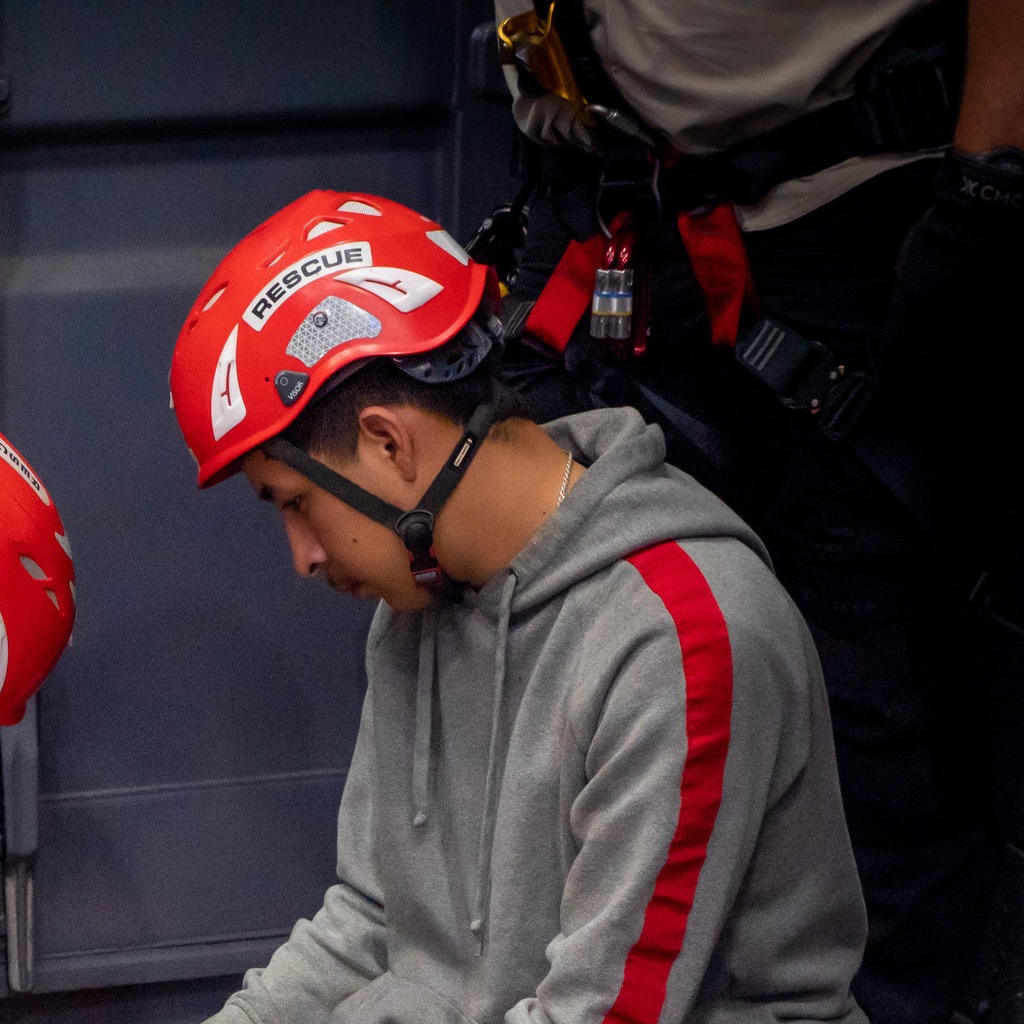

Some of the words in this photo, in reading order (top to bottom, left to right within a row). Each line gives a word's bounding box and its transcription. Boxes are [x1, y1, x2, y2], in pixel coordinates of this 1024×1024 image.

[980, 185, 1024, 208] CMC
[251, 248, 363, 319] RESCUE
[287, 381, 304, 400] VISOR
